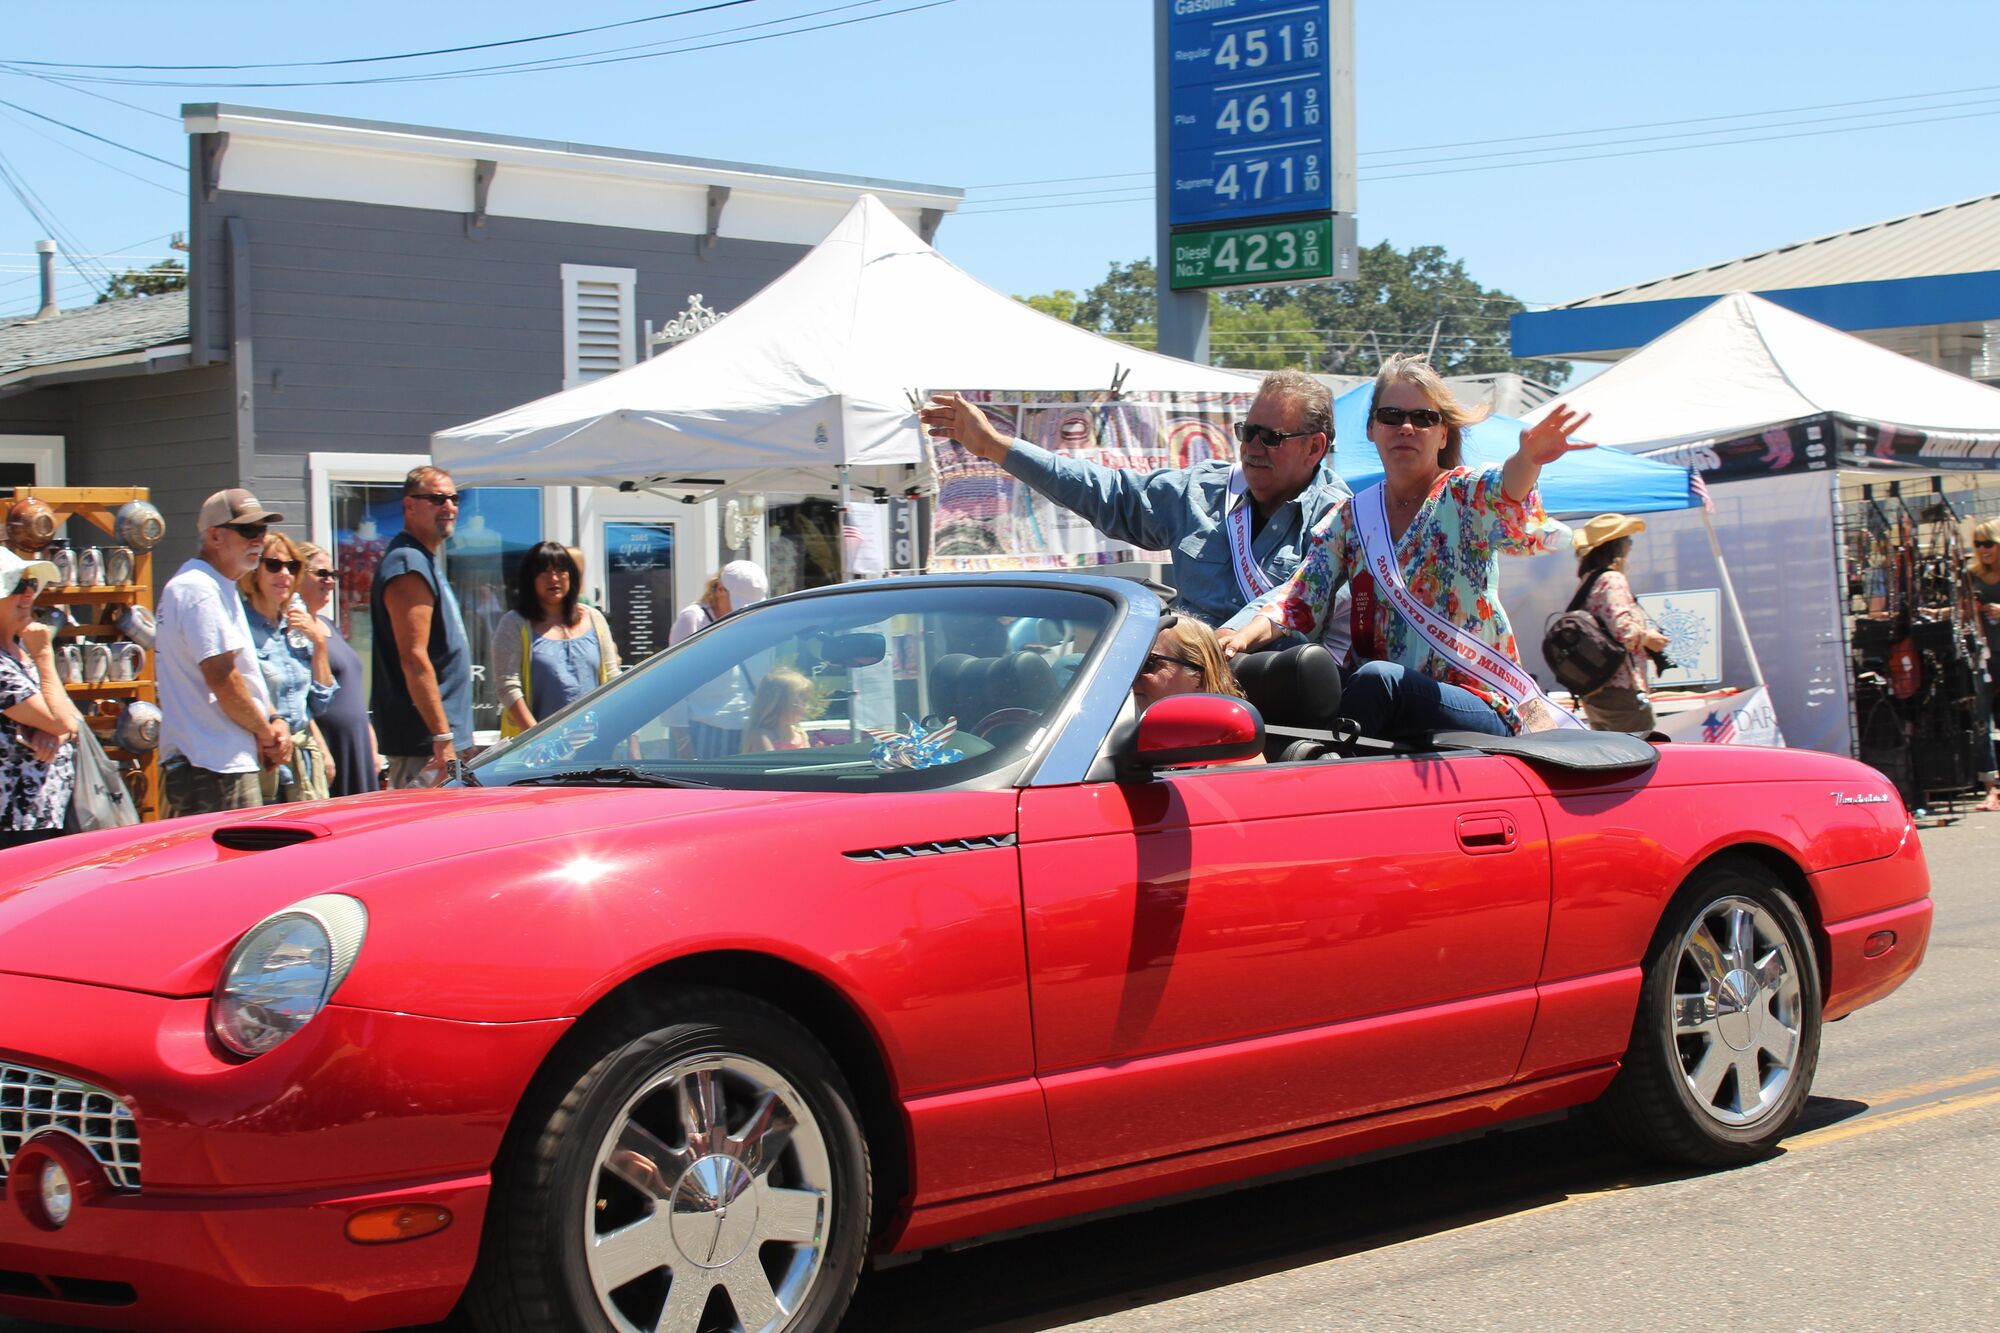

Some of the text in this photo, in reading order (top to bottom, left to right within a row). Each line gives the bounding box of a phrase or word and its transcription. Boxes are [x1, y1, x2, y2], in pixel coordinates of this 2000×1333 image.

[1175, 25, 1292, 70] Regular 451
[1175, 91, 1293, 135] Plus 461
[1175, 157, 1293, 200] Supreme 471
[1176, 232, 1297, 273] Diesel 423
[1176, 262, 1205, 278] No.2
[1377, 555, 1528, 697] 2019 OSYD GRAND MARSHAL
